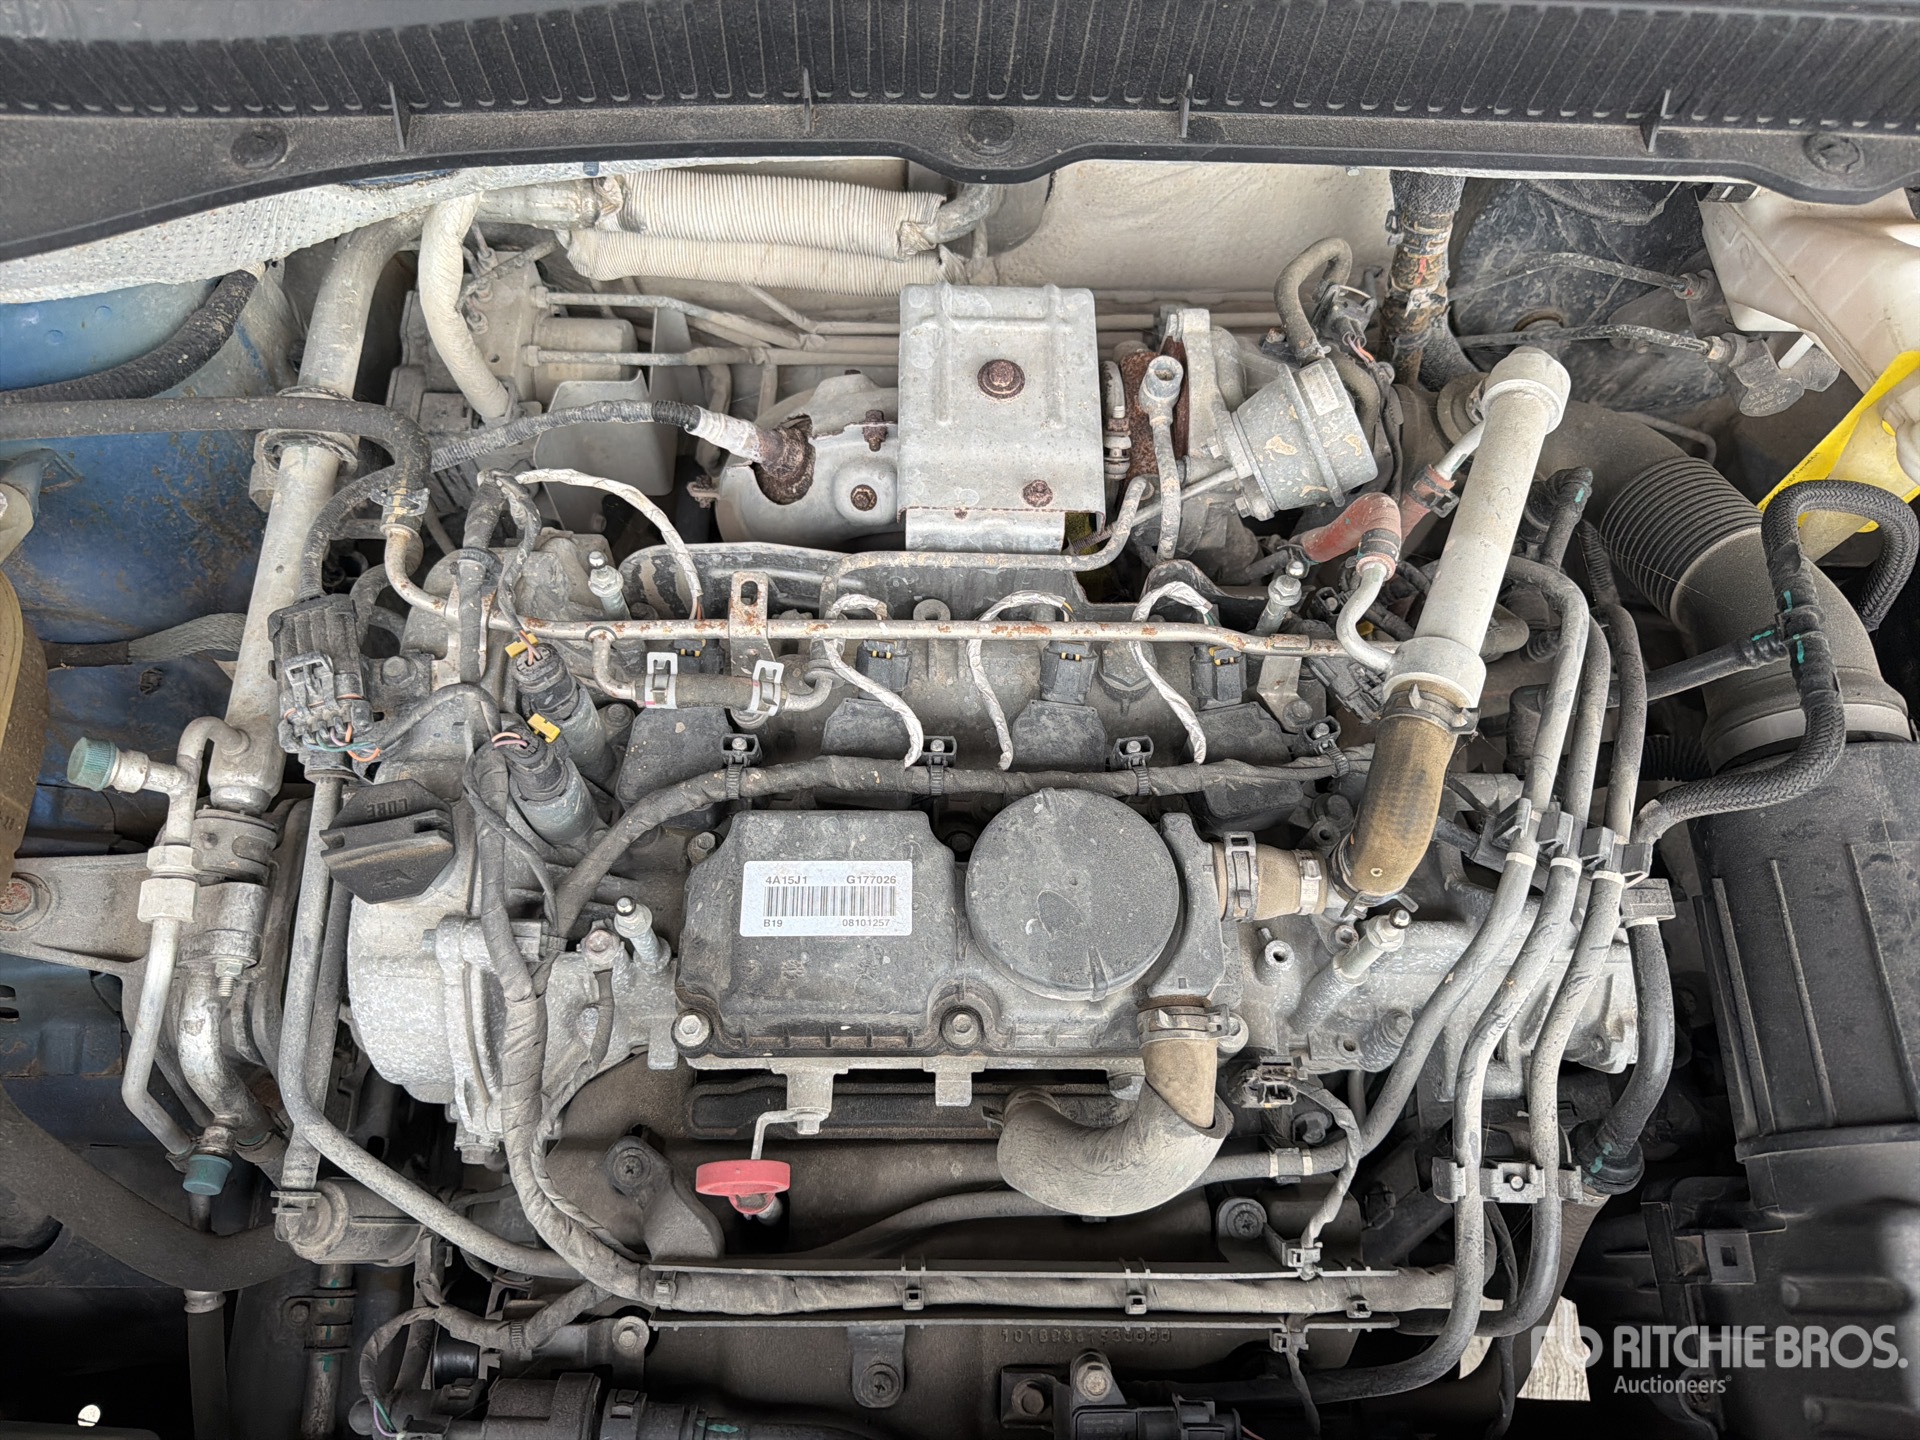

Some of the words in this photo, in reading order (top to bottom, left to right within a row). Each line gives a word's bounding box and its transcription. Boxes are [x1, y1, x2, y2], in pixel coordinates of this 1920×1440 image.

[366, 798, 409, 818] LUBE
[765, 875, 808, 885] 4A15J1
[846, 875, 897, 885] G177026
[763, 919, 783, 928] B19
[842, 918, 891, 927] 08101257
